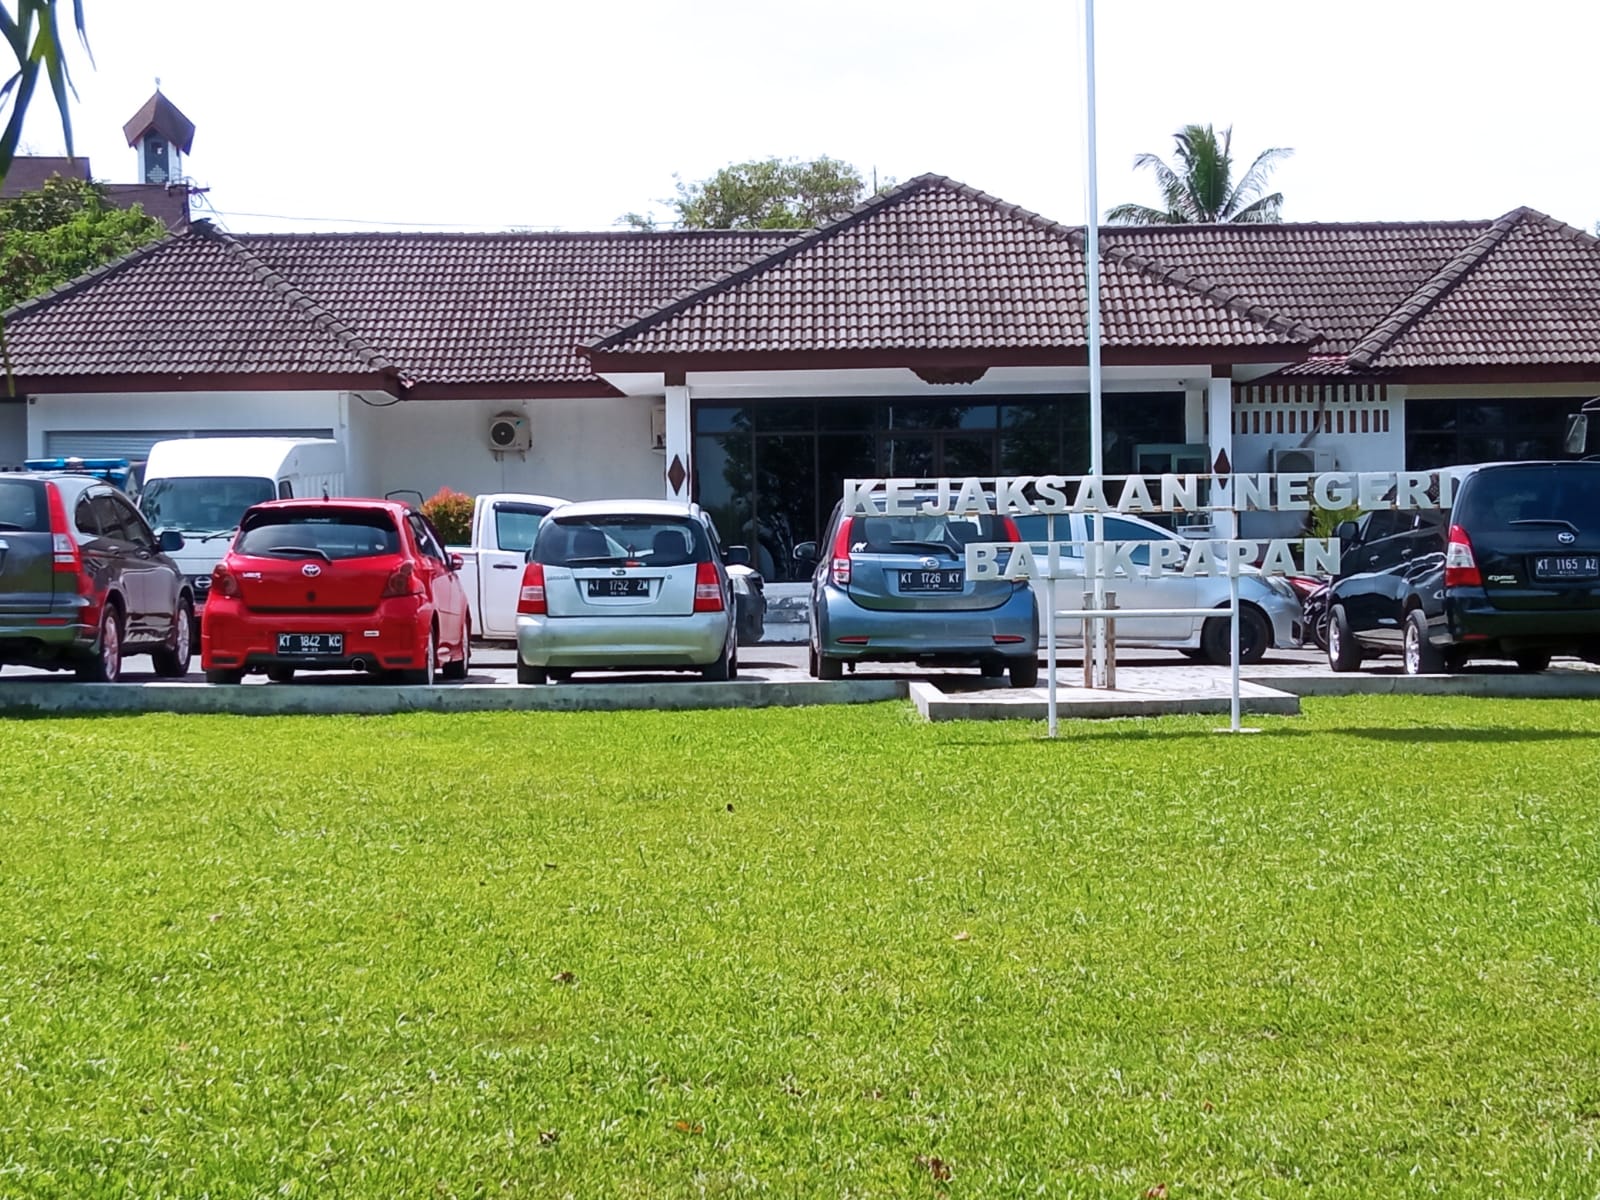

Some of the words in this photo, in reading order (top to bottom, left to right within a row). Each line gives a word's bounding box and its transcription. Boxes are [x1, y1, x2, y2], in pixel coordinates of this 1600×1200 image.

[844, 474, 1198, 516] KEJAKSAAN
[1234, 471, 1452, 511] NEGERI
[965, 537, 1341, 581] BALIKPAPAN
[1537, 559, 1548, 570] KT
[1556, 559, 1578, 570] 1165
[900, 572, 912, 583] KT
[921, 572, 941, 583] 1726
[948, 572, 960, 583] KY
[609, 580, 629, 591] 1752
[279, 635, 291, 647] KT
[300, 635, 320, 647] 1842
